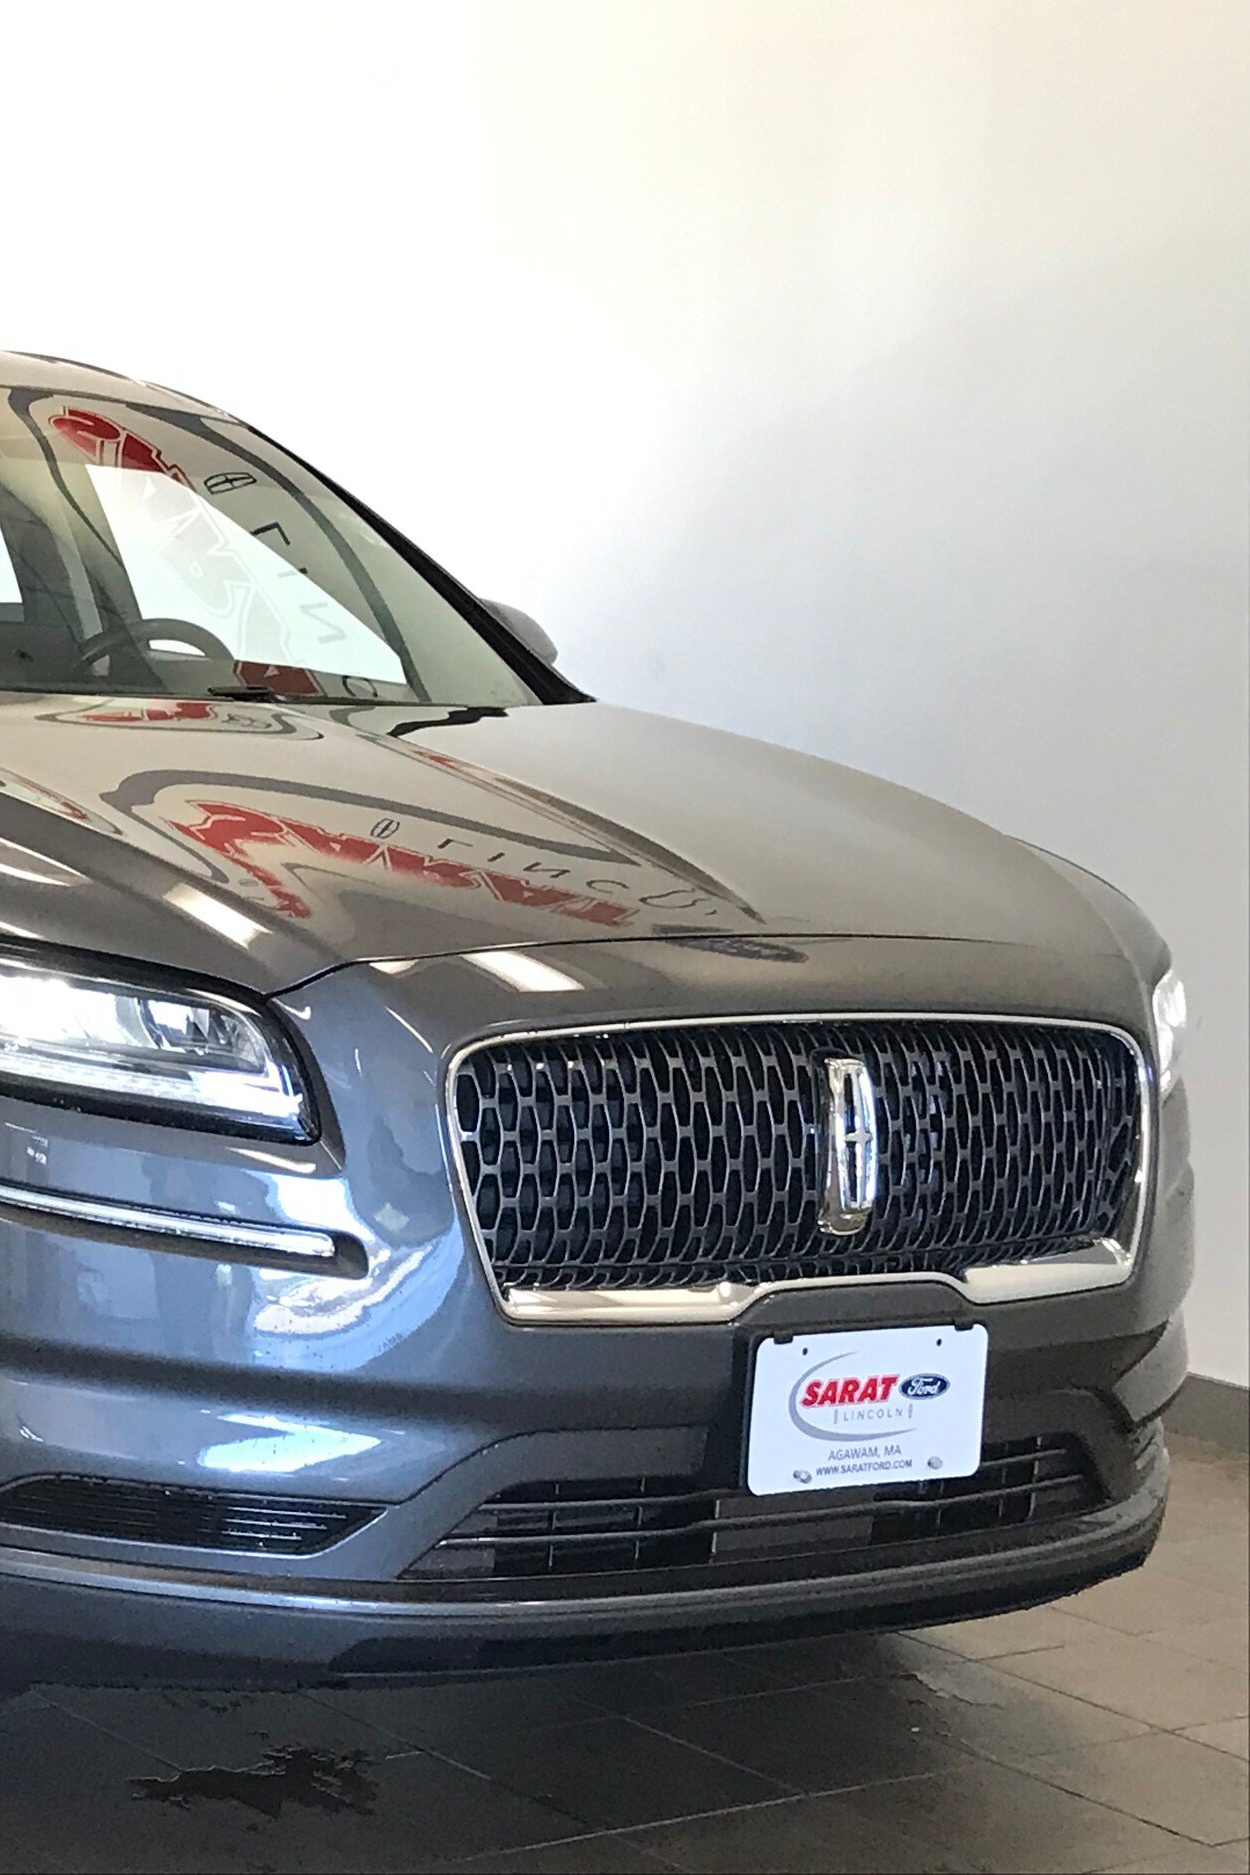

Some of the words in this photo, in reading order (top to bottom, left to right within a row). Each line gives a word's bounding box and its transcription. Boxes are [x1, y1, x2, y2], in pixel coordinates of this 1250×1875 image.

[801, 1374, 899, 1407] SARAT
[905, 1376, 945, 1397] Ford
[843, 1407, 902, 1421] LINCOLN
[828, 1446, 881, 1461] AGAWAM,
[883, 1444, 901, 1456] MA
[815, 1459, 912, 1476] WWW.SARATFORD.COM
